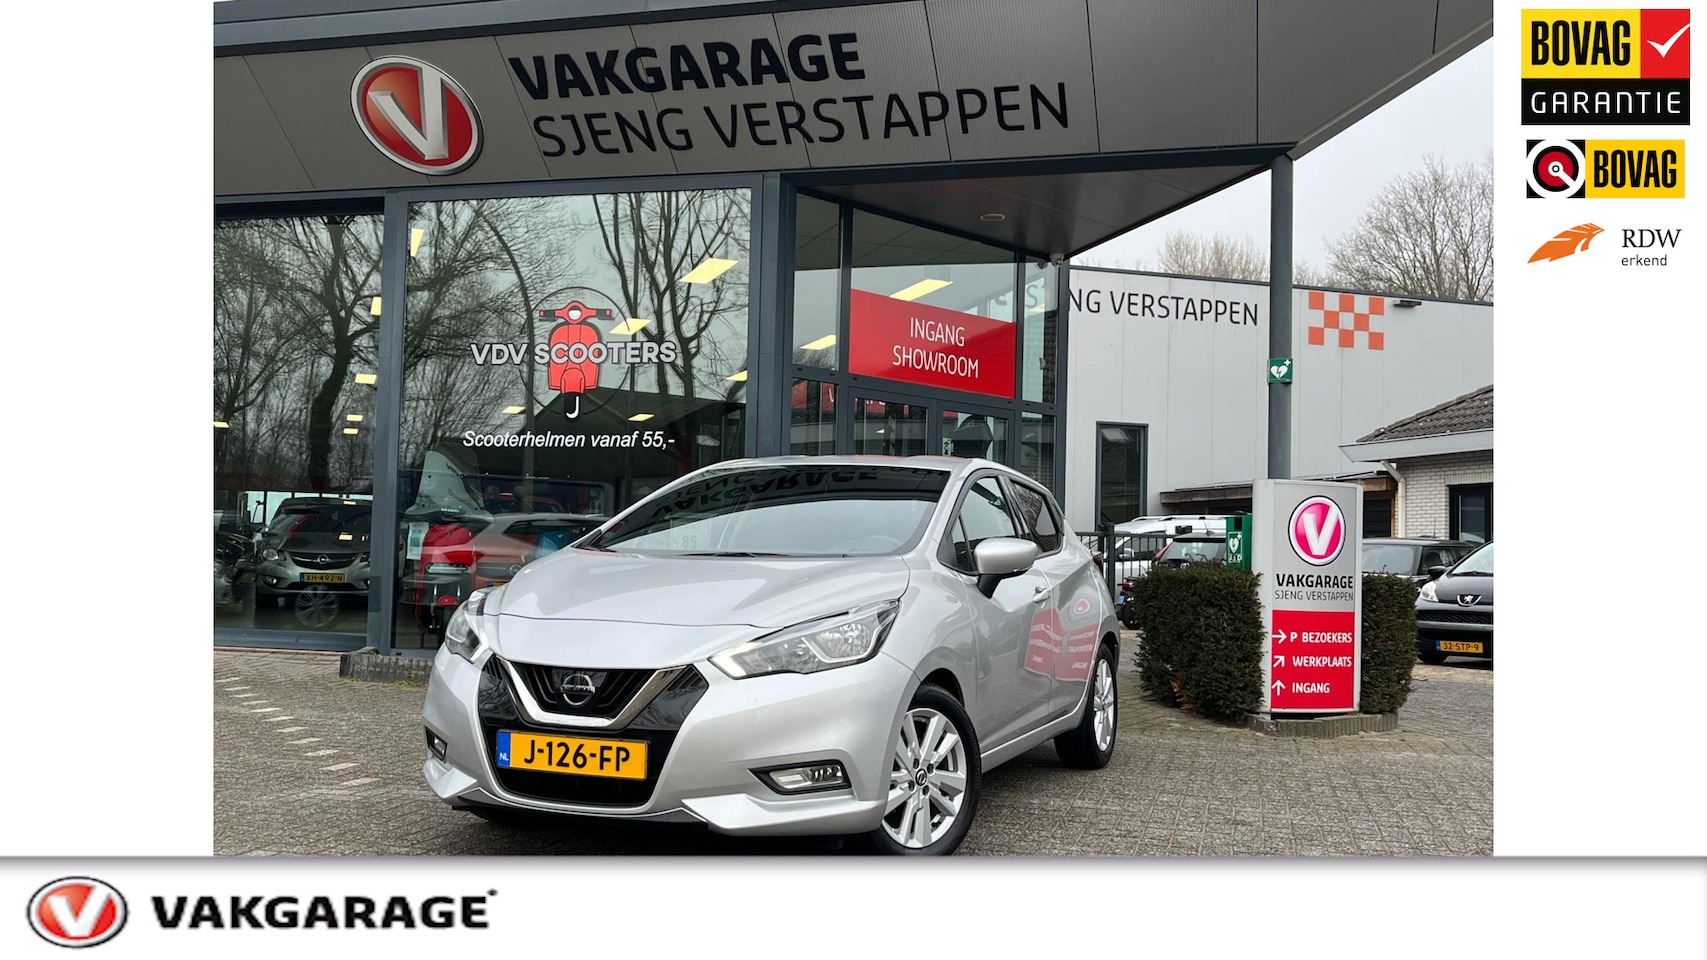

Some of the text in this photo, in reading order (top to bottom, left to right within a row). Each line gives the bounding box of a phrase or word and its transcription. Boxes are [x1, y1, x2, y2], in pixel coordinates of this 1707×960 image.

[508, 33, 865, 99] VAKGARAGE
[533, 82, 1068, 157] SJENG VERSTAPPEN
[1109, 290, 1258, 326] VERSTAPPEN
[910, 317, 965, 347] INGANG
[470, 341, 677, 365] VDV SCOOTERS
[892, 345, 979, 379] SHOWROOM
[463, 430, 675, 450] Scooterhelmen vanaf 55,-
[1276, 573, 1354, 589] VAKGARAGE
[1275, 589, 1354, 602] SJENG VERSTAPPEN
[1290, 631, 1352, 643] P BEZOEKERS
[1443, 642, 1479, 652] 32-STP-9
[1292, 656, 1352, 668] WERKPLAATS
[1292, 682, 1330, 693] INGANG
[499, 752, 509, 761] NL
[523, 739, 630, 772] J-126-FP
